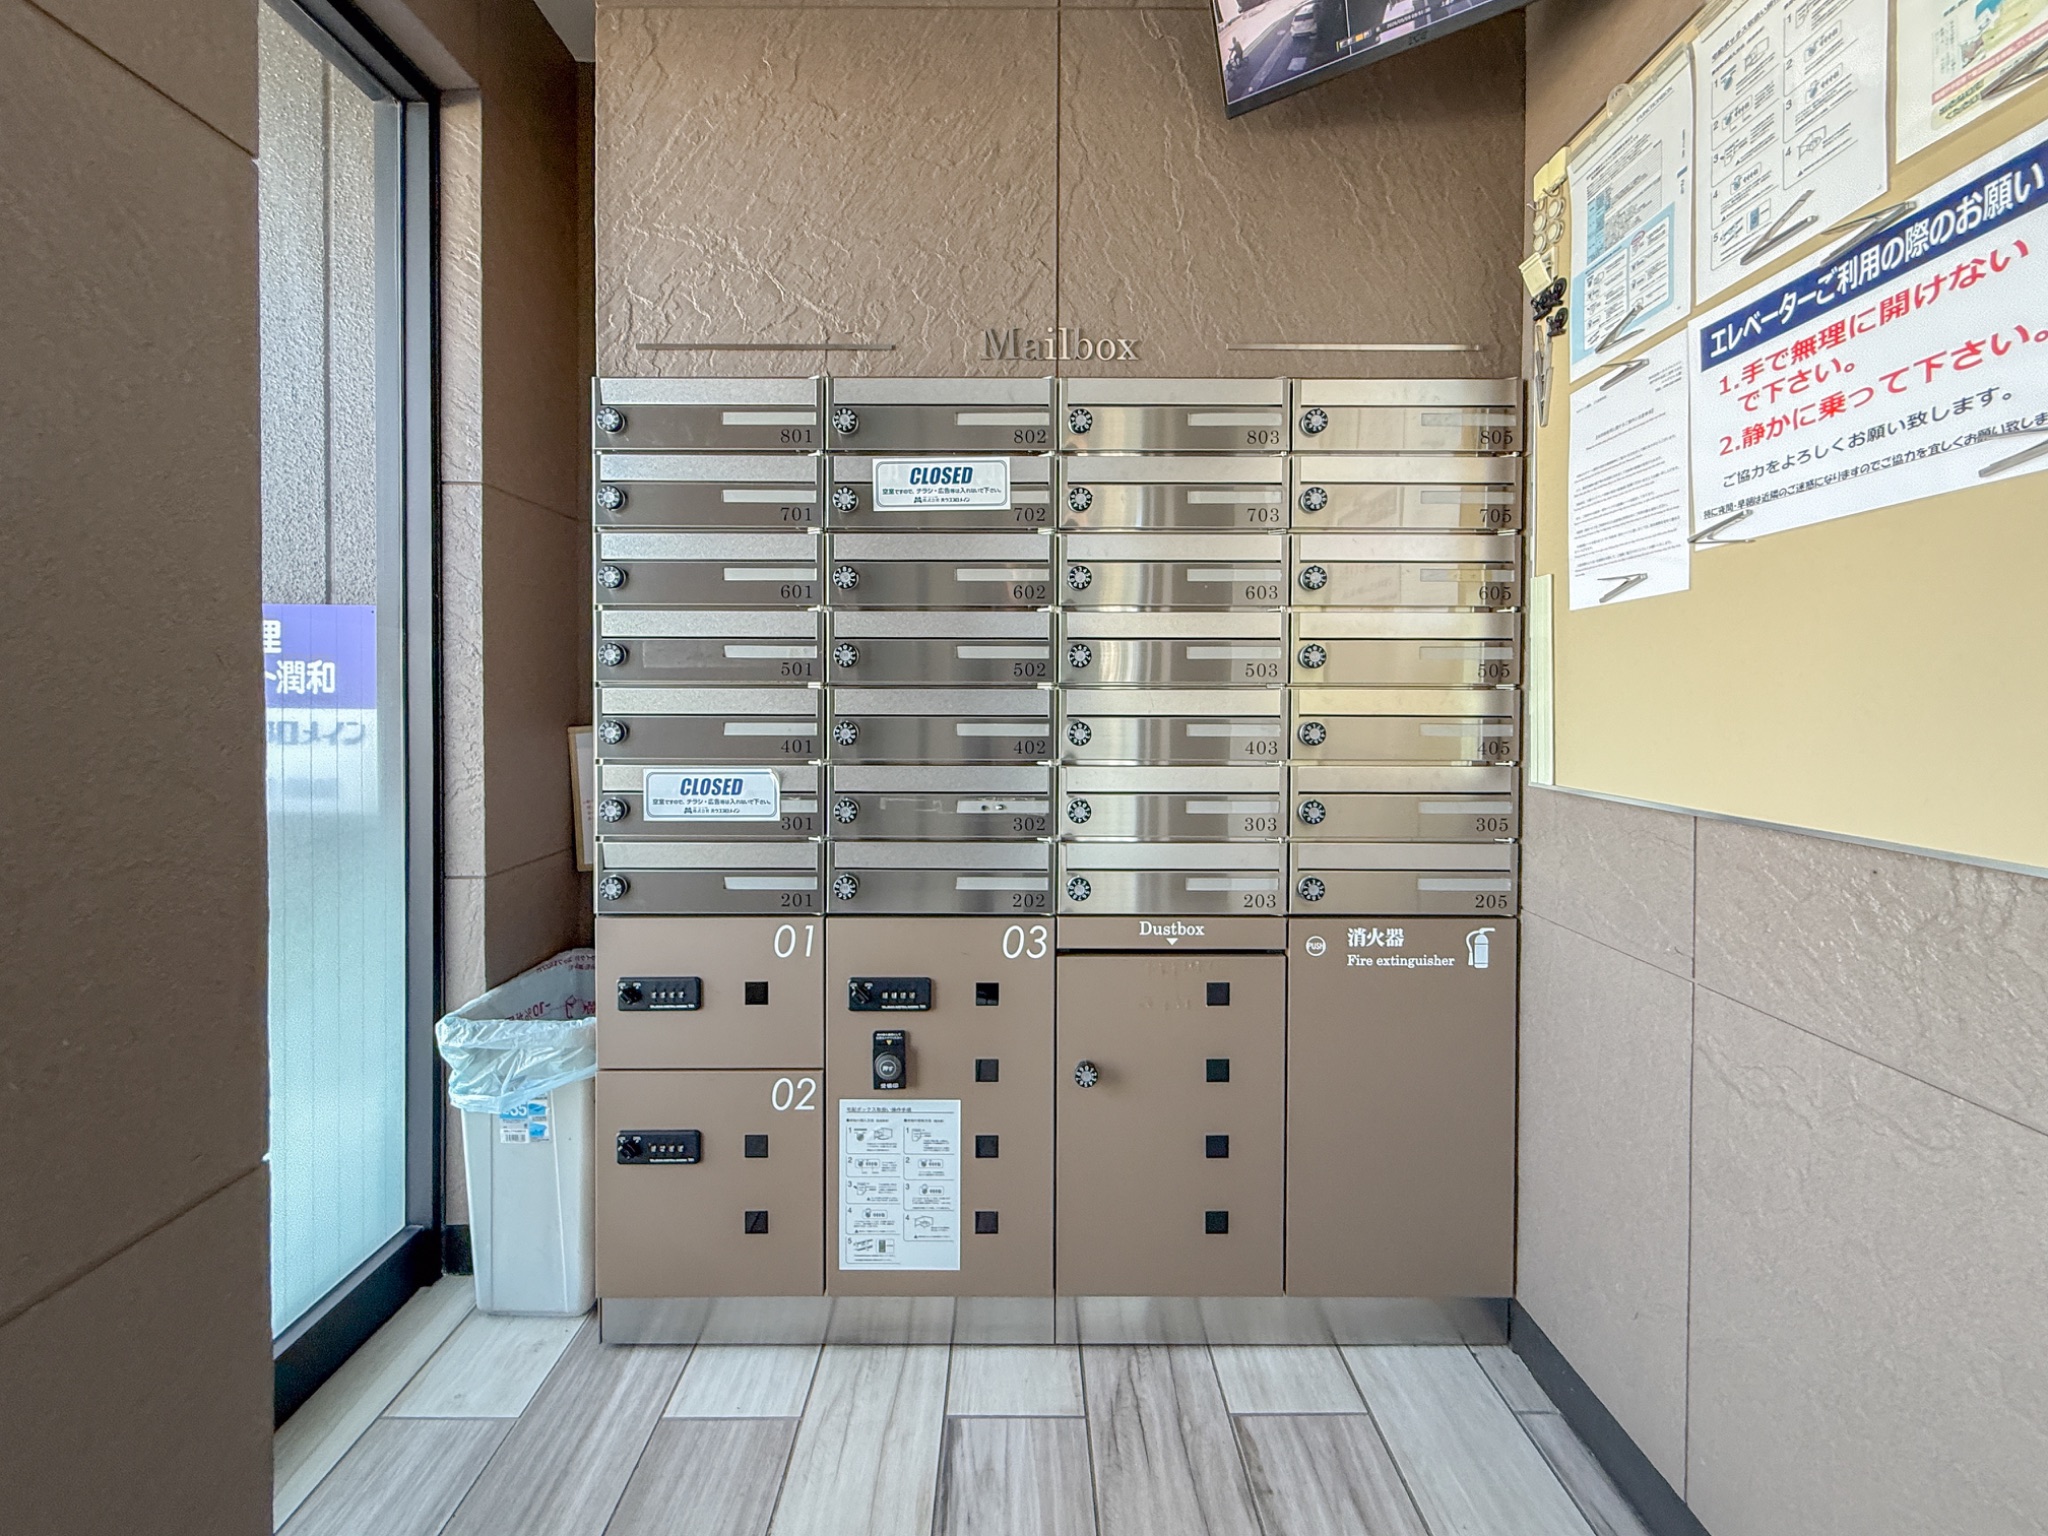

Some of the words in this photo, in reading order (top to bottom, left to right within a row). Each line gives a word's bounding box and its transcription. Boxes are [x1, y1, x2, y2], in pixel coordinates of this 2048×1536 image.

[1710, 163, 2045, 358] エレベーターご利用の際のお願い
[1720, 239, 2029, 395] 1.手で無理に開けない
[981, 327, 1139, 361] Mailbox
[1737, 357, 1855, 412] で下さい。
[780, 428, 814, 444] 801
[1013, 428, 1047, 444] 802
[1246, 429, 1280, 445] 803
[1479, 429, 1513, 445] 805
[1723, 387, 2012, 488] ご協力をよろしくお願い致します。
[909, 466, 974, 486] CLOSED
[780, 507, 814, 522] 701
[1013, 507, 1047, 522] 702
[1246, 508, 1280, 523] 703
[1479, 508, 1513, 523] 705
[780, 584, 814, 599] 601
[1013, 584, 1047, 599] 602
[1245, 585, 1279, 600] 603
[1478, 585, 1512, 600] 605
[780, 662, 814, 677] 501
[1013, 662, 1047, 677] 502
[1244, 663, 1278, 678] 503
[1477, 663, 1511, 678] 505
[780, 739, 814, 754] 401
[1013, 739, 1047, 754] 402
[1244, 740, 1278, 755] 403
[1477, 740, 1510, 755] 405
[680, 777, 744, 796] CLOSED
[781, 817, 814, 831] 301
[1013, 817, 1047, 831] 302
[1244, 817, 1277, 832] 303
[1475, 817, 1509, 832] 305
[780, 893, 814, 908] 201
[1012, 893, 1046, 908] 202
[1243, 894, 1277, 909] 203
[1475, 894, 1508, 909] 205
[1138, 920, 1205, 937] Dustbox
[773, 924, 815, 958] 01
[1001, 924, 1049, 960] 03
[1347, 927, 1405, 948] 消火器
[1347, 954, 1374, 966] Fire
[1376, 954, 1456, 968] extinguisher
[771, 1077, 817, 1111] 02
